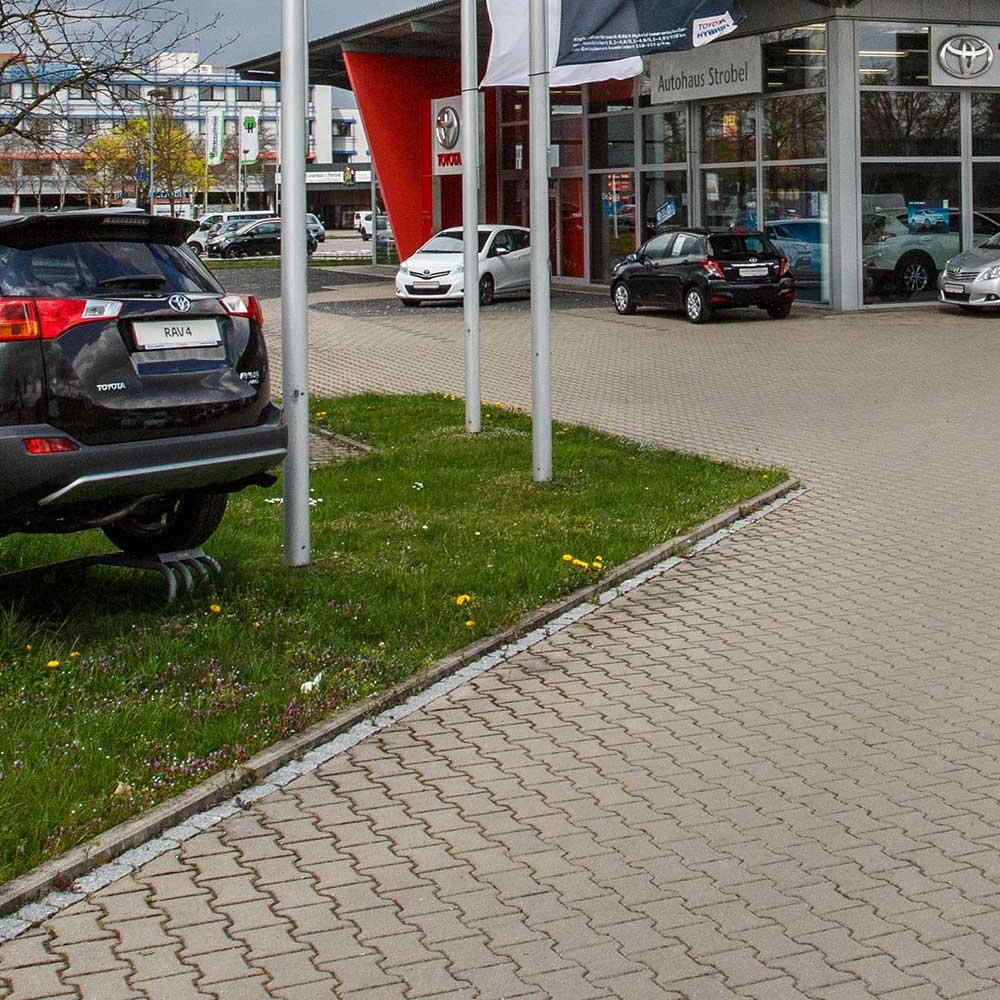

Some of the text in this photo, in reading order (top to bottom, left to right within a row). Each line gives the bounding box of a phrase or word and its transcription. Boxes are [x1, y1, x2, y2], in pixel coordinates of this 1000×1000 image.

[658, 61, 748, 93] Autohaus Strobel
[437, 152, 463, 168] TOYOTA
[96, 382, 126, 391] TOYOTA
